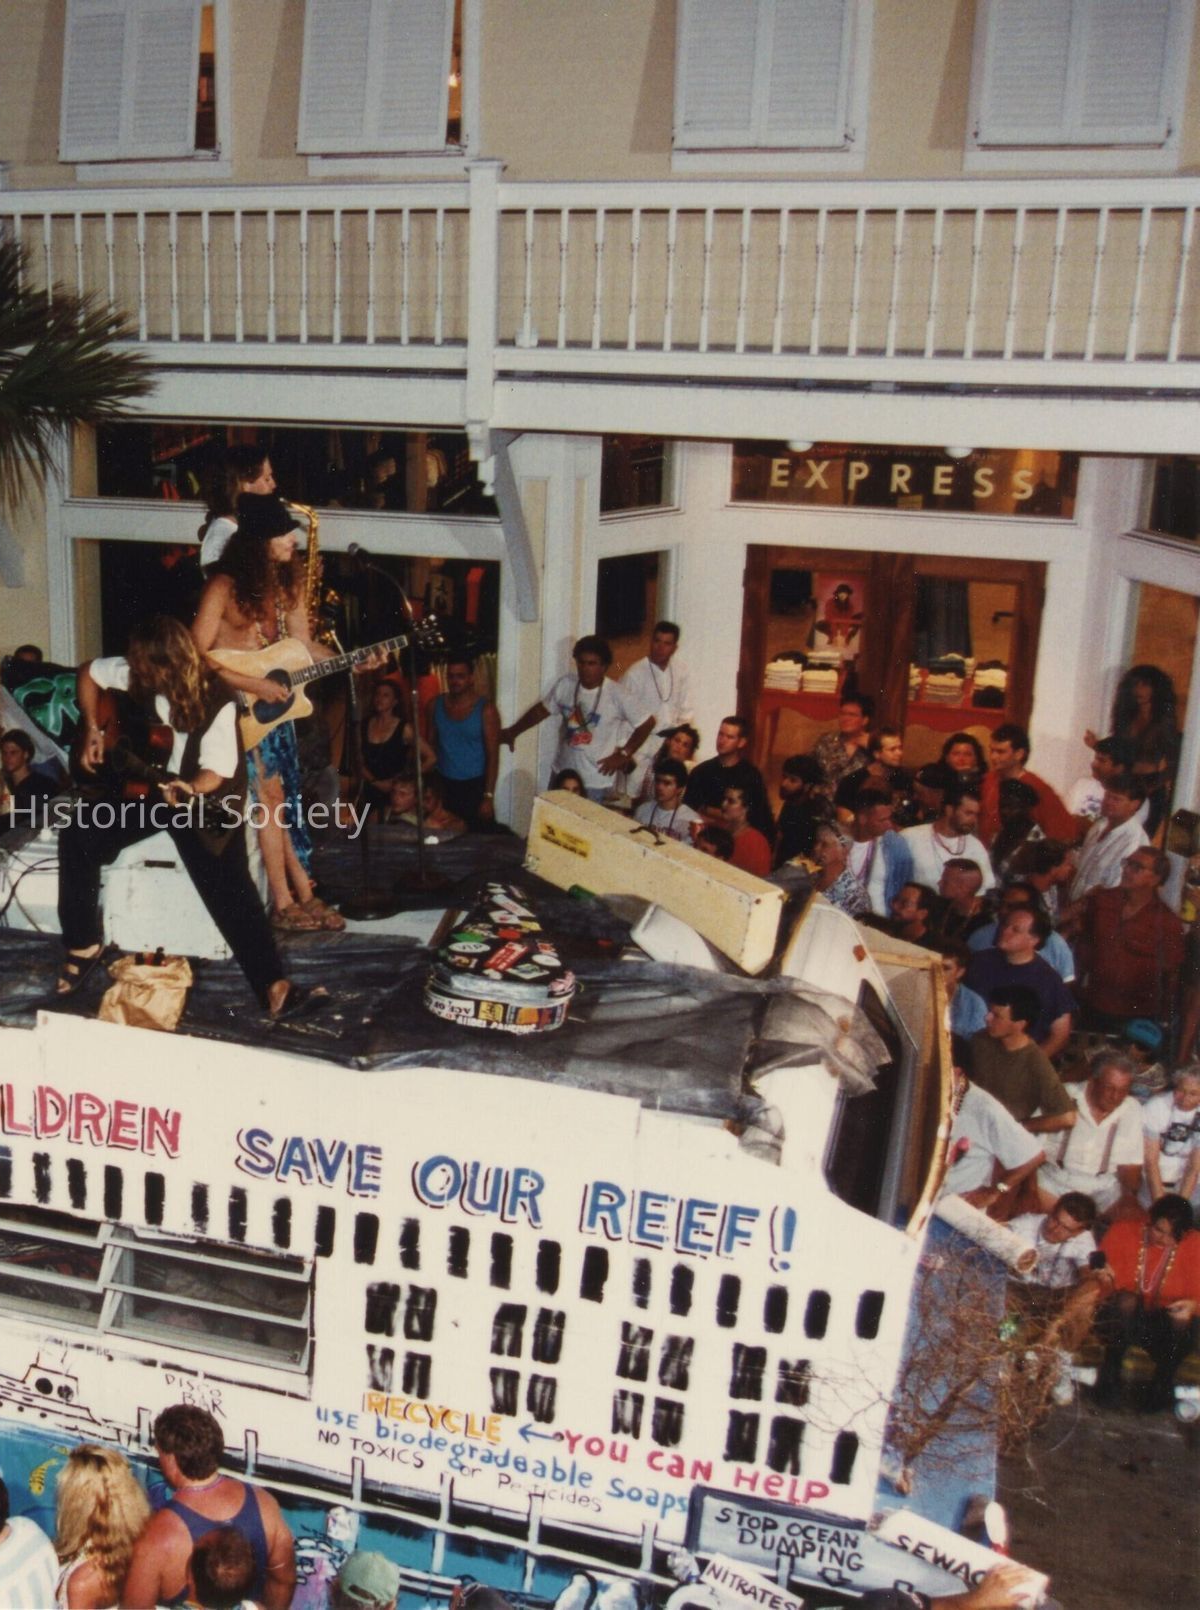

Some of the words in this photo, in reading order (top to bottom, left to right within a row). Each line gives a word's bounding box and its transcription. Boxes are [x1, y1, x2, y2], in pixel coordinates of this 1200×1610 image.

[770, 458, 1034, 500] EXPRESS
[235, 1127, 383, 1198] SAVE
[412, 1154, 545, 1230] OUR
[579, 1180, 797, 1272] REEF!
[165, 1373, 222, 1398] DISCO
[182, 1390, 227, 1418] BAR
[362, 1392, 502, 1446] RECYCLE
[318, 1429, 340, 1446] NO
[350, 1437, 425, 1469] TOXICS
[459, 1465, 482, 1477] or
[497, 1472, 602, 1513] Pesticides
[606, 1478, 688, 1519] Soaps
[715, 1507, 779, 1533] STOP
[786, 1523, 861, 1550] OCEAN
[737, 1528, 865, 1573] DUMPING
[705, 1562, 798, 1609] NITRATES
